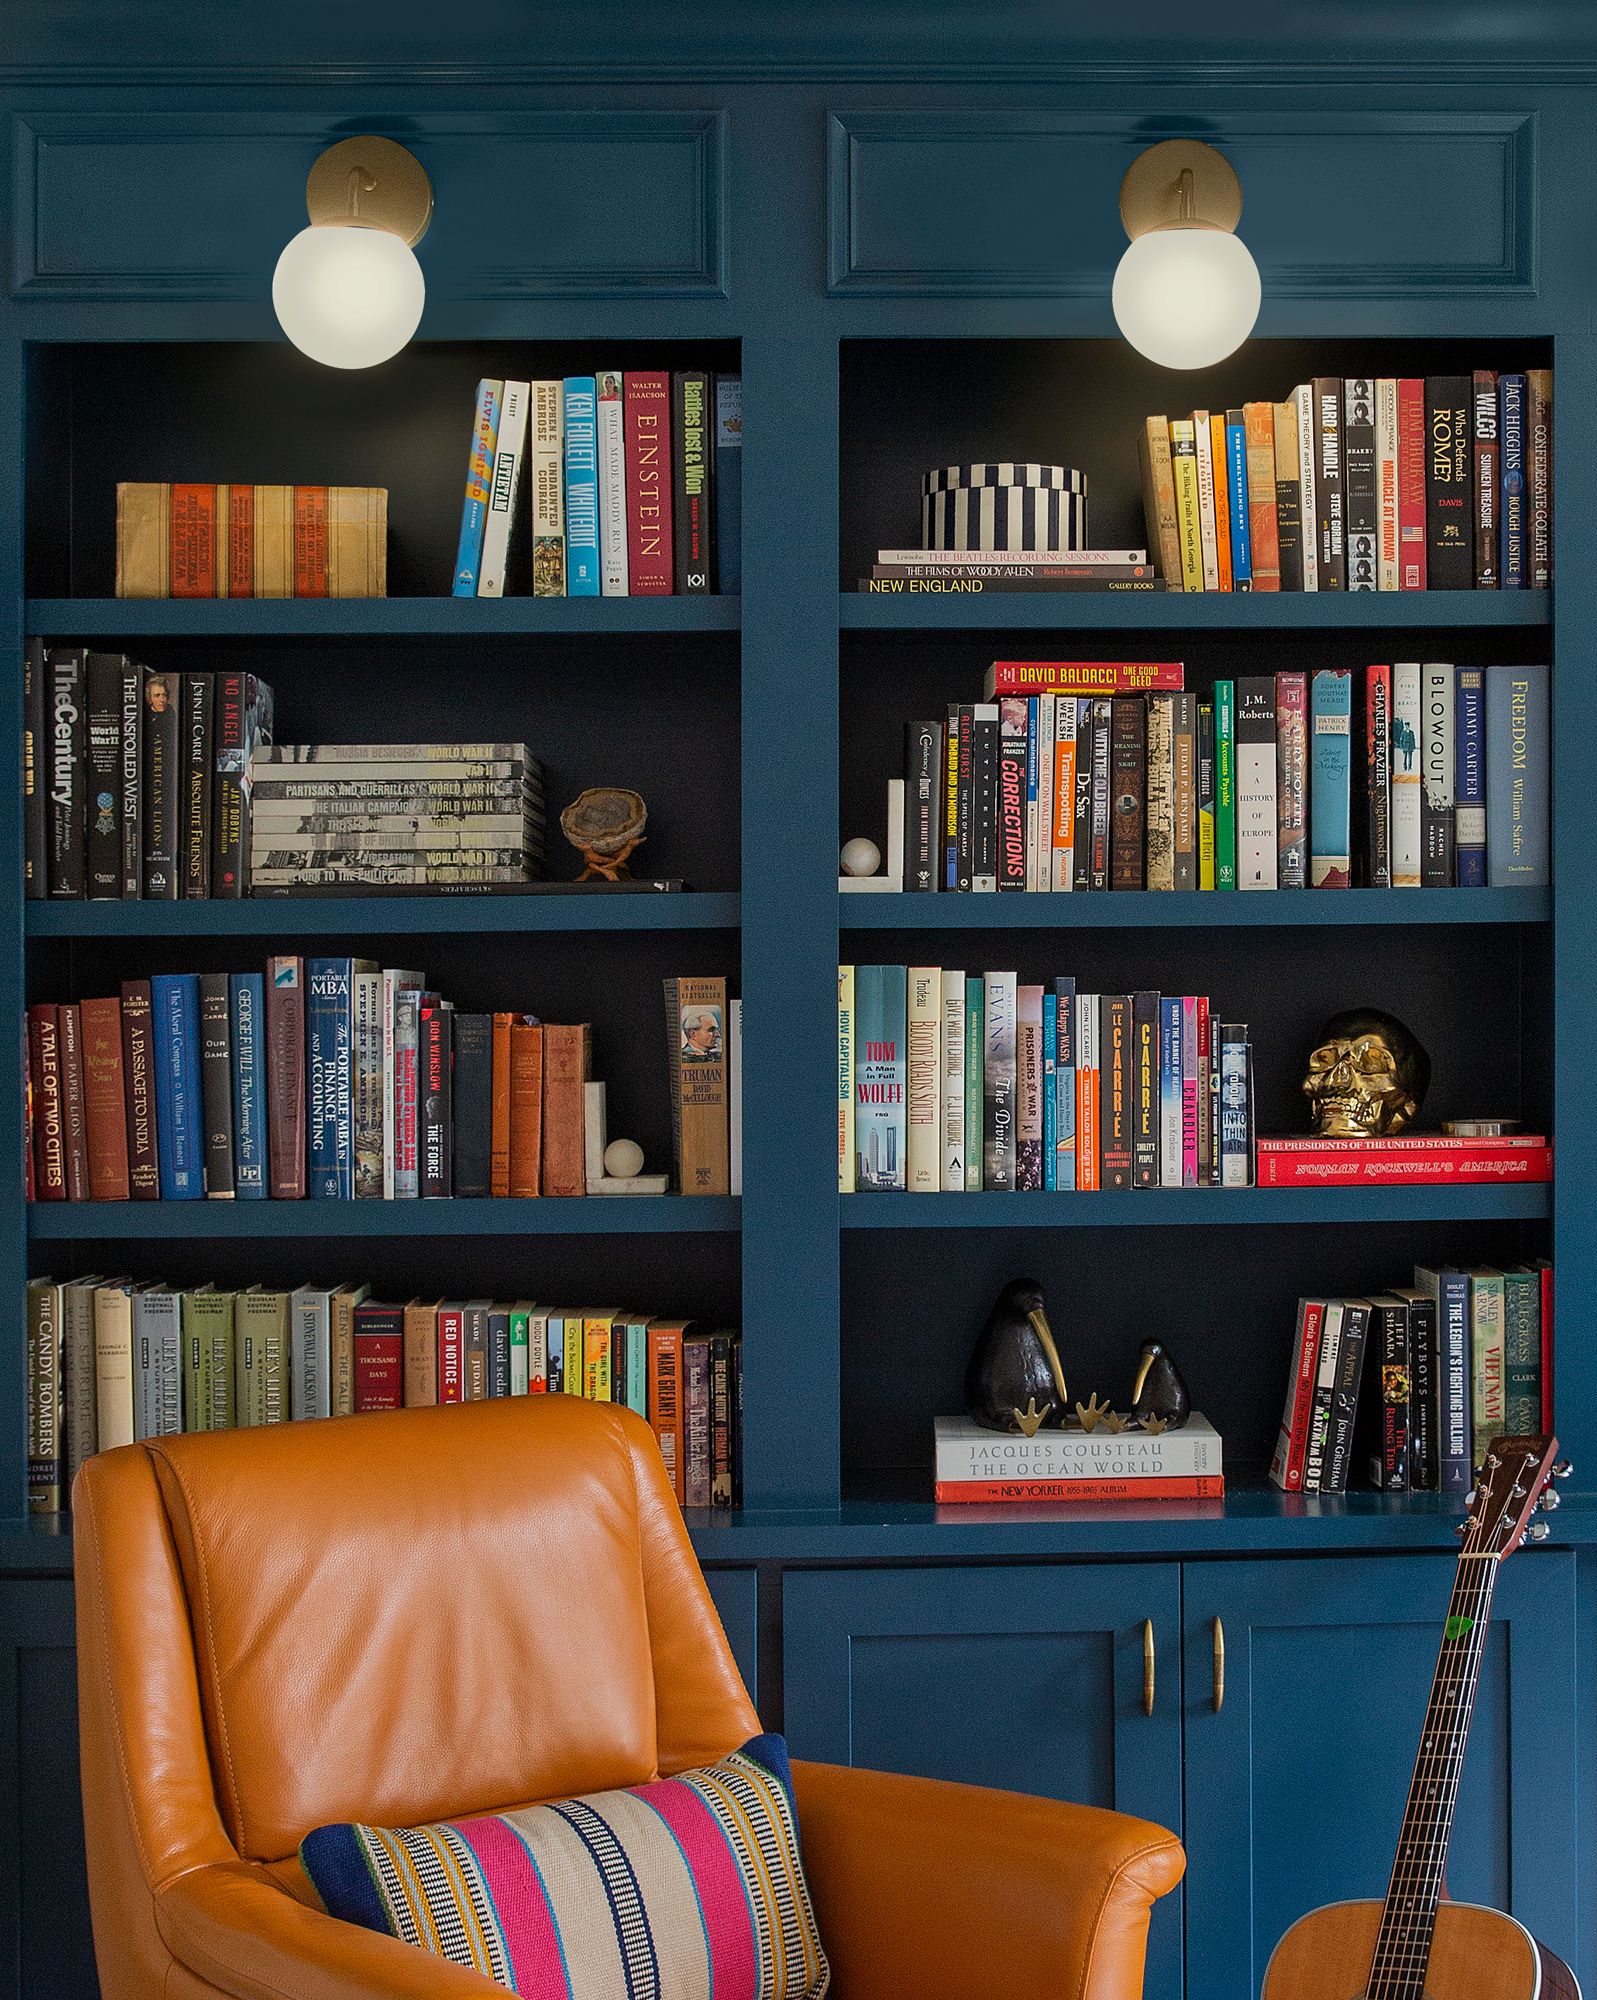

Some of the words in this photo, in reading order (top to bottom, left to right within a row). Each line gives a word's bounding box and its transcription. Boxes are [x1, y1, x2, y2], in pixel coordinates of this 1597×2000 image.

[480, 391, 494, 431] ELVIS
[566, 393, 593, 417] KEN
[629, 391, 666, 399] ISAACSON
[1506, 381, 1522, 412] JACK
[537, 387, 547, 441] AMBROSE
[1409, 399, 1424, 432] TOM
[1455, 409, 1466, 436] Who
[1476, 392, 1496, 440] WILCO
[567, 422, 594, 471] FOLLETT
[1433, 408, 1452, 483] ROME?
[1455, 438, 1467, 482] Defends
[1506, 415, 1521, 469] HIGGINS
[472, 437, 488, 497] IGNITED
[494, 454, 514, 511] ANTIETAM
[1382, 460, 1394, 504] MIRACLE
[1409, 437, 1424, 506] BROKAW
[1480, 454, 1492, 487] SUNKEN
[1534, 425, 1547, 510] CONFEDERATE
[539, 470, 548, 519] COURAGE
[548, 461, 558, 527] UNDAUNTED
[637, 414, 660, 557] EINSTEIN
[1182, 476, 1192, 498] Hiking
[568, 482, 595, 548] WHITEOUT
[1184, 500, 1193, 518] Trails
[1330, 493, 1342, 518] STEVE
[1382, 506, 1394, 517] AT
[1481, 488, 1492, 528] TREASURE
[1509, 496, 1520, 531] ROUGH
[1187, 527, 1195, 546] North
[1331, 520, 1342, 555] GORMAN
[1383, 520, 1395, 562] MIDWAY
[1508, 534, 1520, 573] JUSTICE
[1535, 510, 1547, 561] GOLIATH
[1187, 548, 1197, 573] Georgia
[869, 580, 905, 592] NEW
[910, 580, 984, 592] ENGLAND
[124, 675, 137, 703] THE
[225, 678, 239, 695] NO
[1020, 668, 1055, 683] DAVID
[1060, 668, 1117, 684] BALDACCI
[1123, 666, 1137, 676] ONE
[1138, 666, 1159, 676] GOOD
[1130, 676, 1151, 686] DEED
[225, 703, 239, 745] ANGEL
[1239, 710, 1274, 719] Roberts
[1375, 684, 1385, 736] CHARLES
[1466, 693, 1477, 738] JIMMY
[1511, 680, 1529, 770] FREEDOM
[124, 704, 138, 779] UNSPOILED
[1096, 728, 1107, 758] WITH
[1431, 676, 1444, 784] BLOWOUT
[948, 738, 958, 770] RIMBAUD
[1095, 757, 1107, 778] THE
[1375, 741, 1385, 787] FRAZIER
[1466, 742, 1477, 795] CARTER
[948, 771, 958, 785] AND
[948, 786, 958, 799] JIM
[1059, 751, 1073, 838] Trainspotting
[1077, 773, 1091, 794] Dr.
[1094, 779, 1107, 801] OLD
[1201, 758, 1211, 795] Deliverance
[124, 780, 138, 820] WEST
[191, 770, 203, 826] ABSOLUTE
[1076, 796, 1090, 819] Sax
[1512, 779, 1523, 820] William
[948, 799, 958, 836] MORRISON
[1001, 760, 1024, 877] CORRECTIONS
[1094, 801, 1107, 836] BREED
[1375, 795, 1387, 858] Nightwoods
[190, 830, 202, 877] FRIENDS
[1512, 824, 1523, 856] Safire
[311, 982, 348, 995] MBA
[917, 979, 930, 1007] Trudeau
[41, 1021, 54, 1033] A
[131, 1027, 142, 1038] A
[430, 1021, 440, 1040] DON
[840, 1010, 850, 1034] HOW
[989, 984, 1004, 1053] EVANS
[42, 1034, 56, 1072] TALE
[865, 1042, 895, 1062] TOM
[910, 1021, 937, 1057] BLOODY
[68, 1063, 78, 1101] PAPER
[132, 1040, 146, 1095] PASSAGE
[242, 1077, 252, 1094] The
[430, 1045, 440, 1091] WINSLOW
[682, 1068, 722, 1082] TRUMAN
[840, 1037, 850, 1099] CAPITALISM
[910, 1060, 937, 1091] ROADS
[43, 1075, 57, 1097] OF
[325, 1061, 336, 1122] FINANCE
[858, 1083, 903, 1104] WOLFE
[994, 1078, 1011, 1104] The
[45, 1099, 58, 1135] TWO
[70, 1106, 80, 1137] LION
[135, 1097, 147, 1116] TO
[240, 1096, 253, 1135] Morning
[910, 1093, 937, 1125] SOUTH
[1183, 1087, 1195, 1151] CHANDLER
[1223, 1113, 1246, 1125] INTO
[136, 1118, 149, 1155] INDIA
[242, 1137, 252, 1159] After
[428, 1125, 439, 1143] THE
[994, 1108, 1011, 1155] Divide
[46, 1138, 61, 1186] CITIES
[428, 1146, 439, 1178] FORCE
[1296, 1163, 1359, 1176] NORMAN
[1363, 1162, 1454, 1176] ROCKWELL'S
[1459, 1160, 1528, 1174] AMERICA
[41, 1295, 50, 1318] THE
[1449, 1302, 1462, 1322] THE
[1476, 1284, 1487, 1325] KARNOW
[1519, 1283, 1530, 1362] BLUEGRASS
[303, 1312, 316, 1361] STONEWALL
[445, 1319, 457, 1341] RED
[534, 1320, 542, 1344] RODDY
[1306, 1313, 1318, 1339] Gloria
[1385, 1312, 1396, 1359] SHAARA
[1449, 1322, 1463, 1365] LEGION'S
[40, 1320, 53, 1377] CANDY
[445, 1344, 457, 1384] NOTICE
[534, 1346, 542, 1369] DOYLE
[657, 1352, 676, 1376] MARK
[1302, 1341, 1314, 1377] Steinem
[304, 1363, 316, 1401] JACKSON
[657, 1380, 676, 1418] GREANEY
[1450, 1366, 1463, 1411] FIGHTING
[1485, 1346, 1500, 1419] VIETNAM
[40, 1382, 53, 1455] BOMBERS
[305, 1403, 316, 1414] AT
[1385, 1407, 1396, 1444] RISING
[1309, 1405, 1325, 1456] MAXIMUM
[1336, 1419, 1348, 1443] JOHN
[1450, 1411, 1464, 1455] BULLDOG
[970, 1445, 1053, 1459] JACQUES
[1063, 1443, 1163, 1457] COUSTEAU
[970, 1463, 1007, 1476] THE
[1016, 1462, 1084, 1475] OCEAN
[1094, 1460, 1163, 1473] WORLD
[1330, 1445, 1345, 1488] GRISHAM
[1385, 1448, 1396, 1472] TIDE
[1306, 1457, 1322, 1488] BOB
